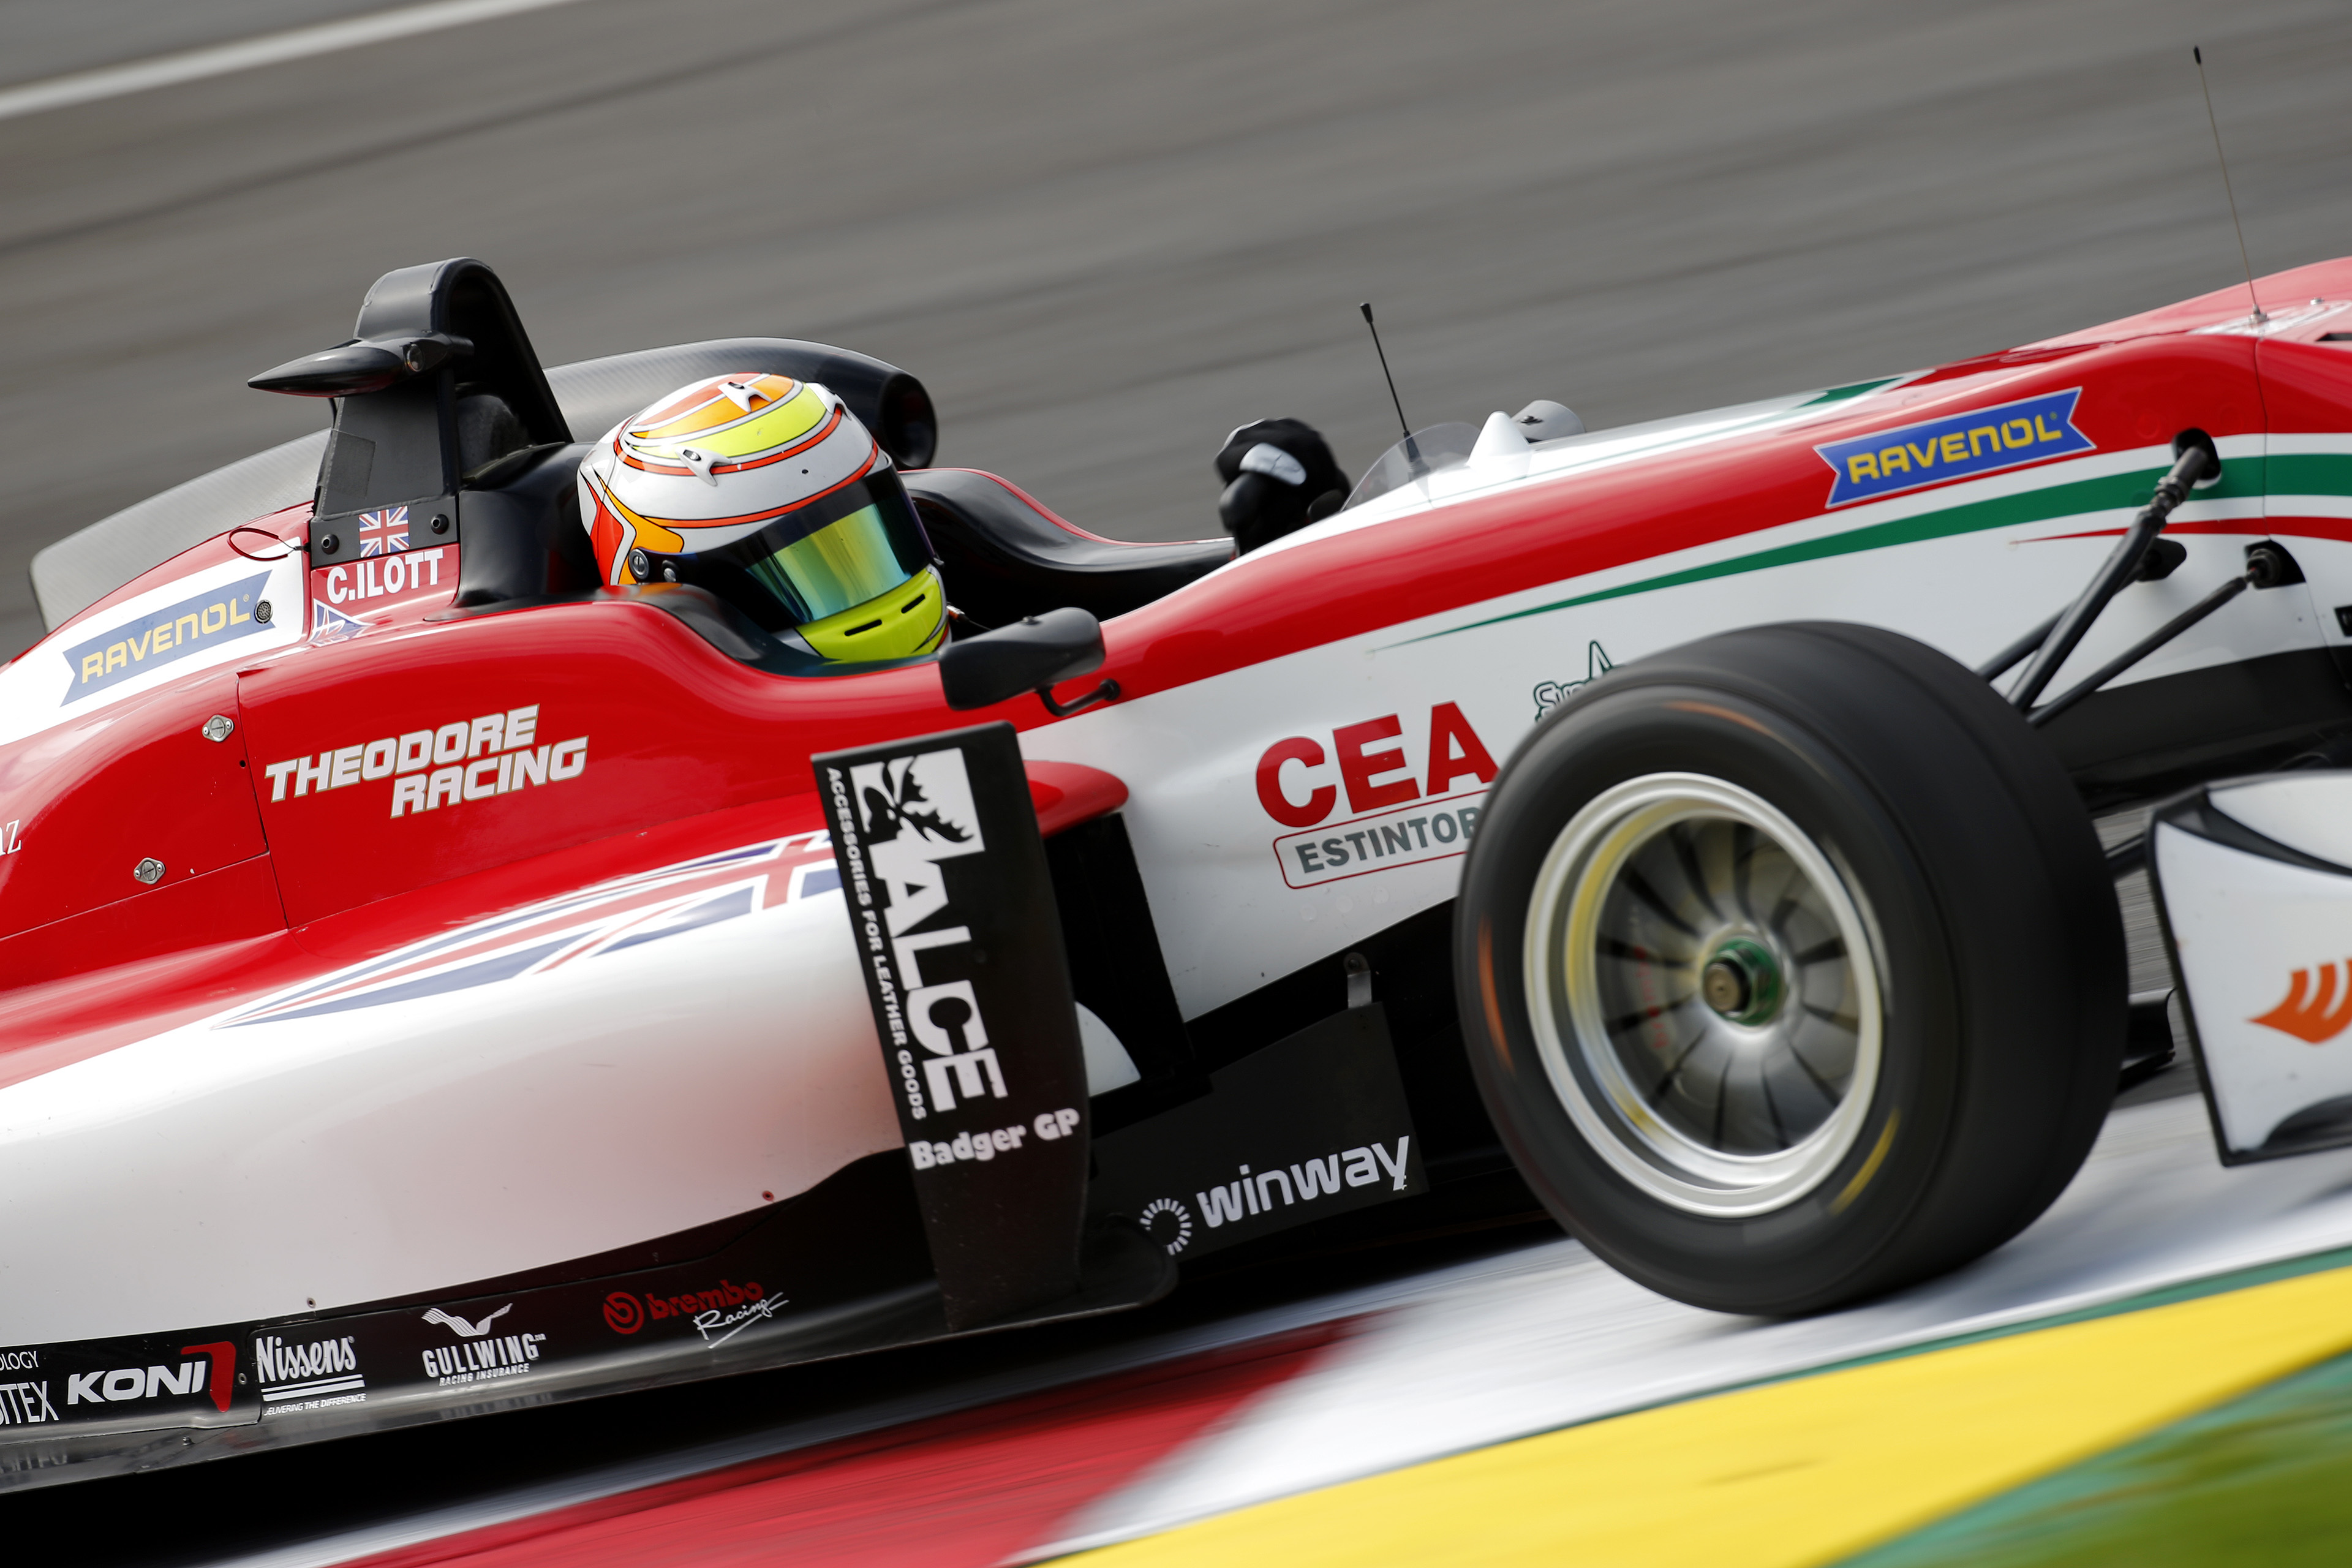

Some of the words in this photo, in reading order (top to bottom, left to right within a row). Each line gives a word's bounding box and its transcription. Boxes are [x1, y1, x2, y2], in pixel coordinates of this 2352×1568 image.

[1846, 415, 2062, 484] RAVENOL
[326, 549, 445, 604] C.ILOTT
[81, 598, 251, 684] RAVENOL
[265, 704, 540, 802] THEODORE
[390, 736, 588, 818] RACING
[1256, 700, 1500, 827] CEA
[827, 767, 872, 906] ACCESSORIES
[862, 910, 883, 951] FOR
[873, 955, 908, 1047] LEATHER
[897, 1050, 927, 1120] GOODS
[869, 843, 1008, 1112] ALCE
[910, 1123, 1027, 1170] Badger
[1033, 1108, 1080, 1140] GP
[1196, 1136, 1409, 1228] winway
[645, 1280, 764, 1320] brembo
[693, 1294, 789, 1341] Racing
[67, 1361, 205, 1405] KONI
[256, 1336, 356, 1383] Nissens
[439, 1373, 473, 1387] RACING
[476, 1363, 530, 1381] INSURANCE
[305, 1400, 320, 1409] THE
[321, 1393, 367, 1408] DIFFERENCE
